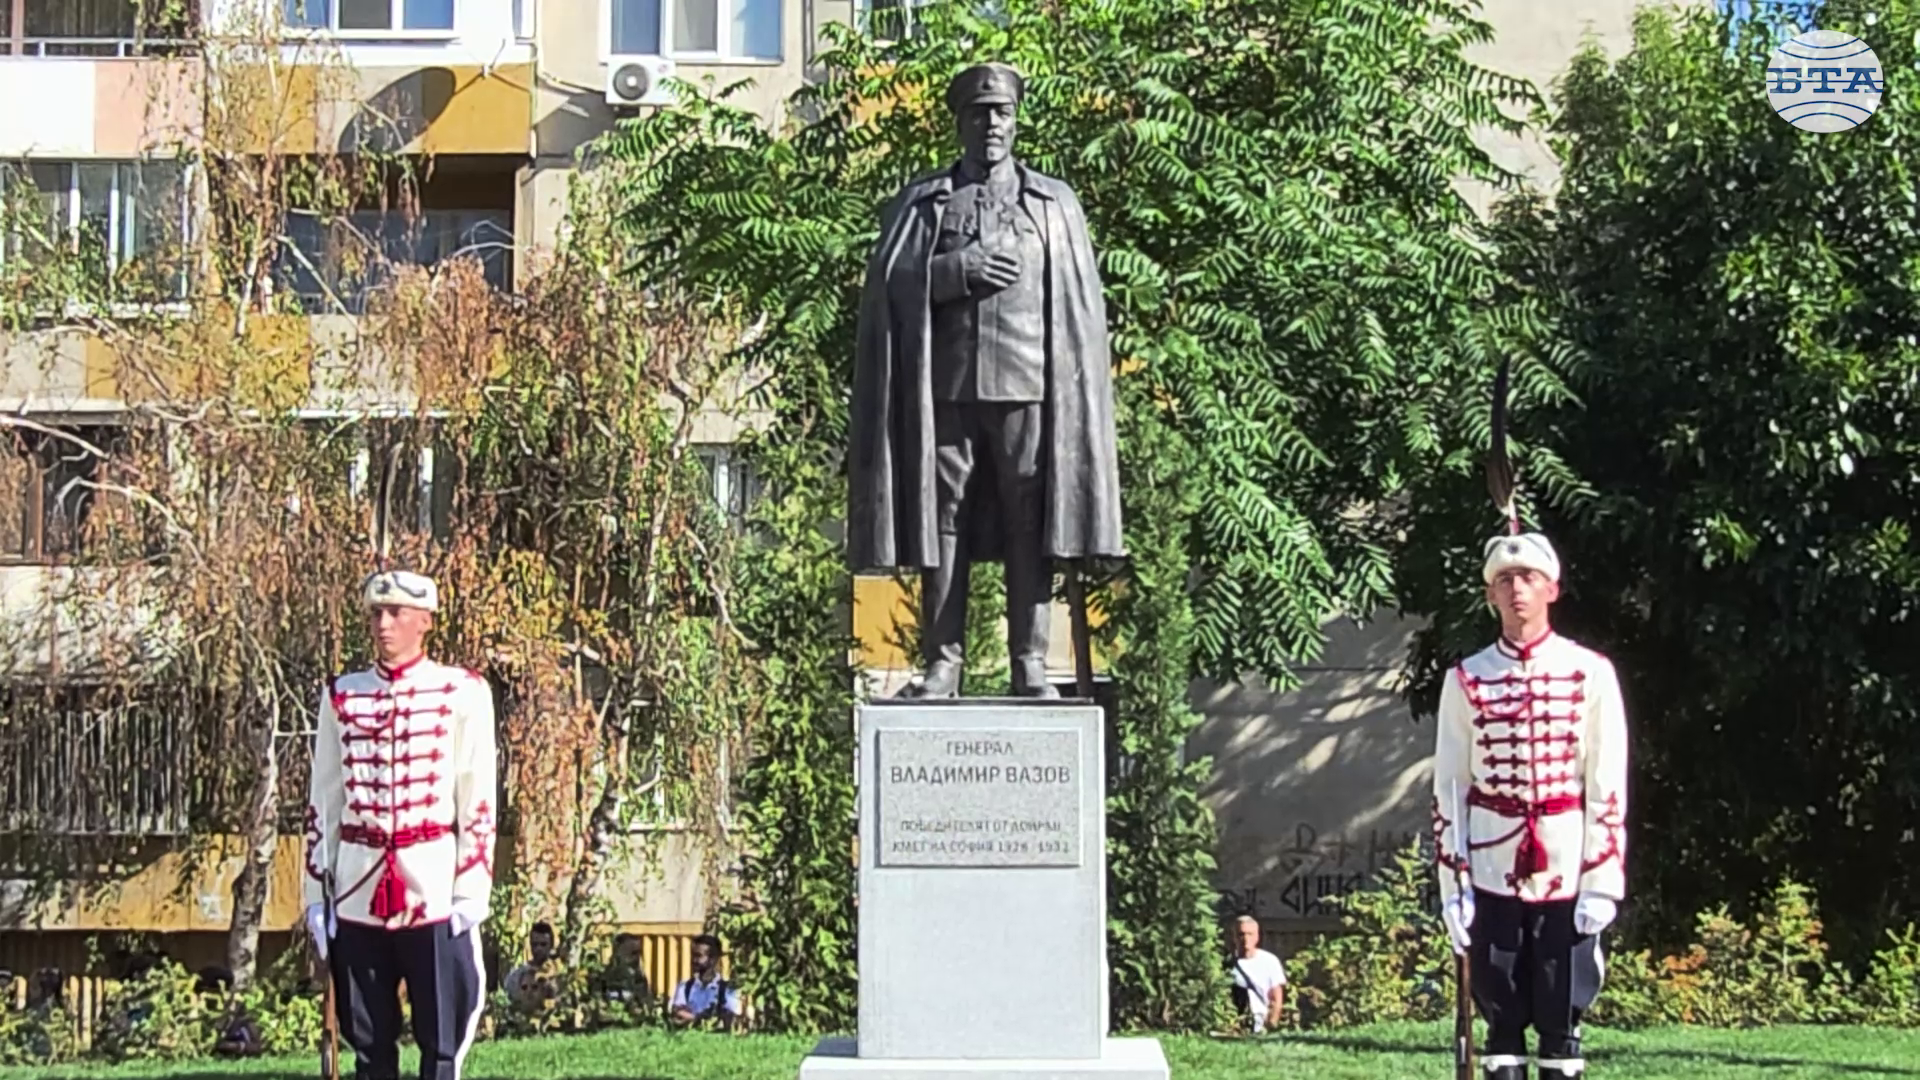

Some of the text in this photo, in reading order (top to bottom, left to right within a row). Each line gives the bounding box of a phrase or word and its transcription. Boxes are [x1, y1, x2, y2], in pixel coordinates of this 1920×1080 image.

[946, 740, 1014, 756] ГЕНЕРАЛ
[890, 766, 1070, 785] ВЛАДИМИР ВАЗОВ
